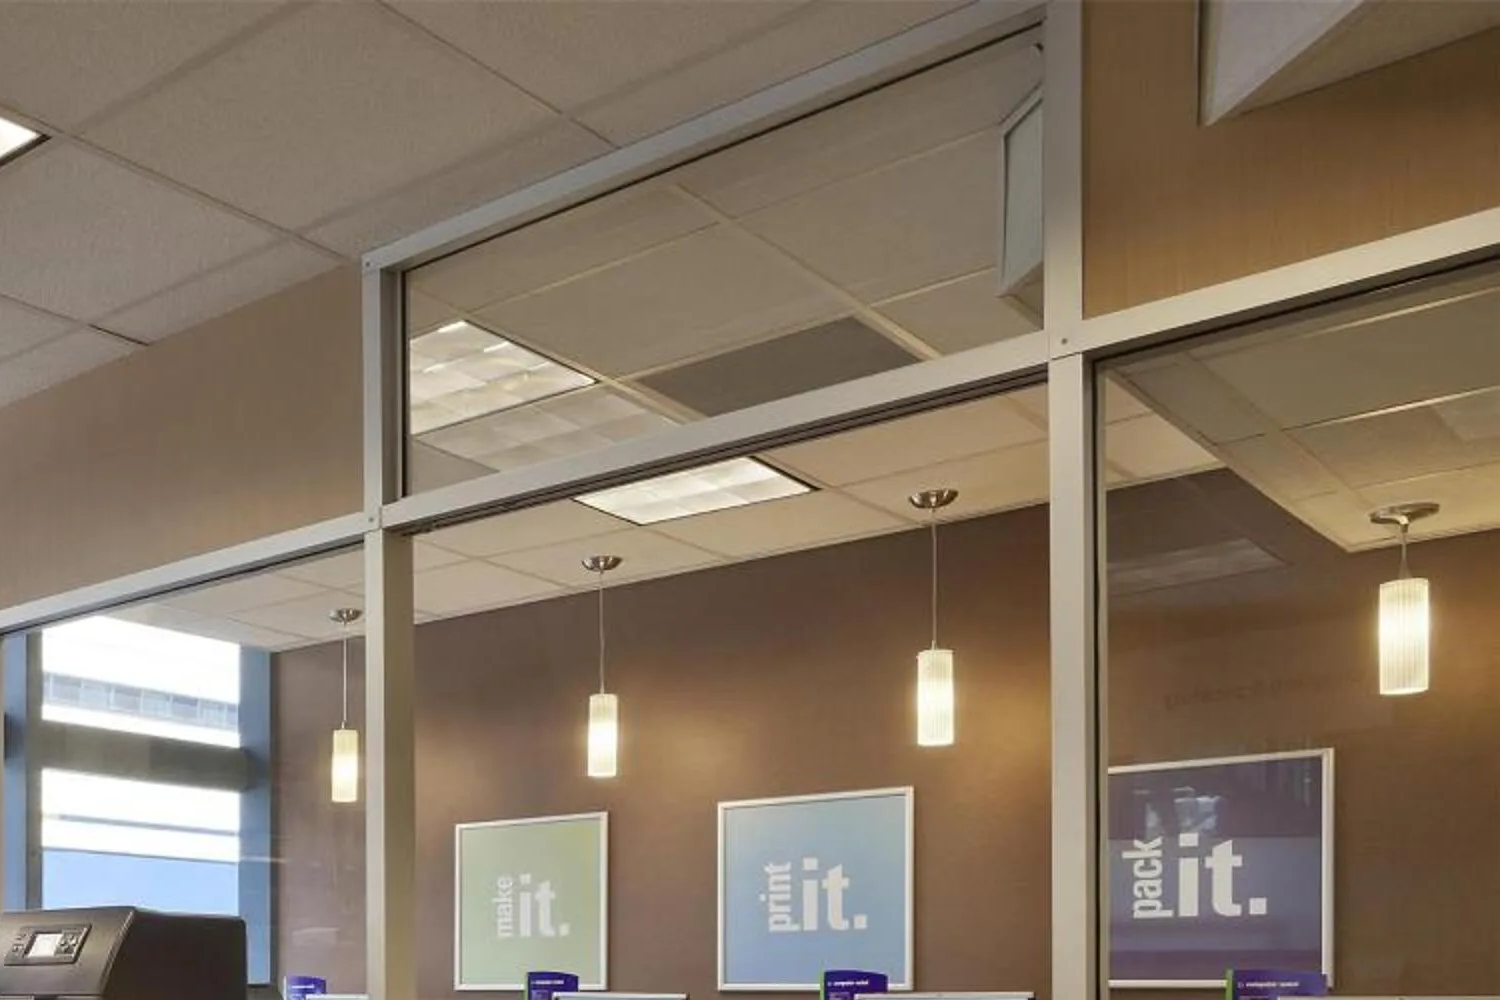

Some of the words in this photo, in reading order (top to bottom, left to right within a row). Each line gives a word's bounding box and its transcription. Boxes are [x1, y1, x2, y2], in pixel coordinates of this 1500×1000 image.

[492, 875, 513, 938] make
[519, 873, 570, 937] it.
[759, 861, 800, 932] print
[802, 857, 868, 931] it.
[1121, 836, 1174, 919] pack
[1178, 832, 1267, 917] it.
